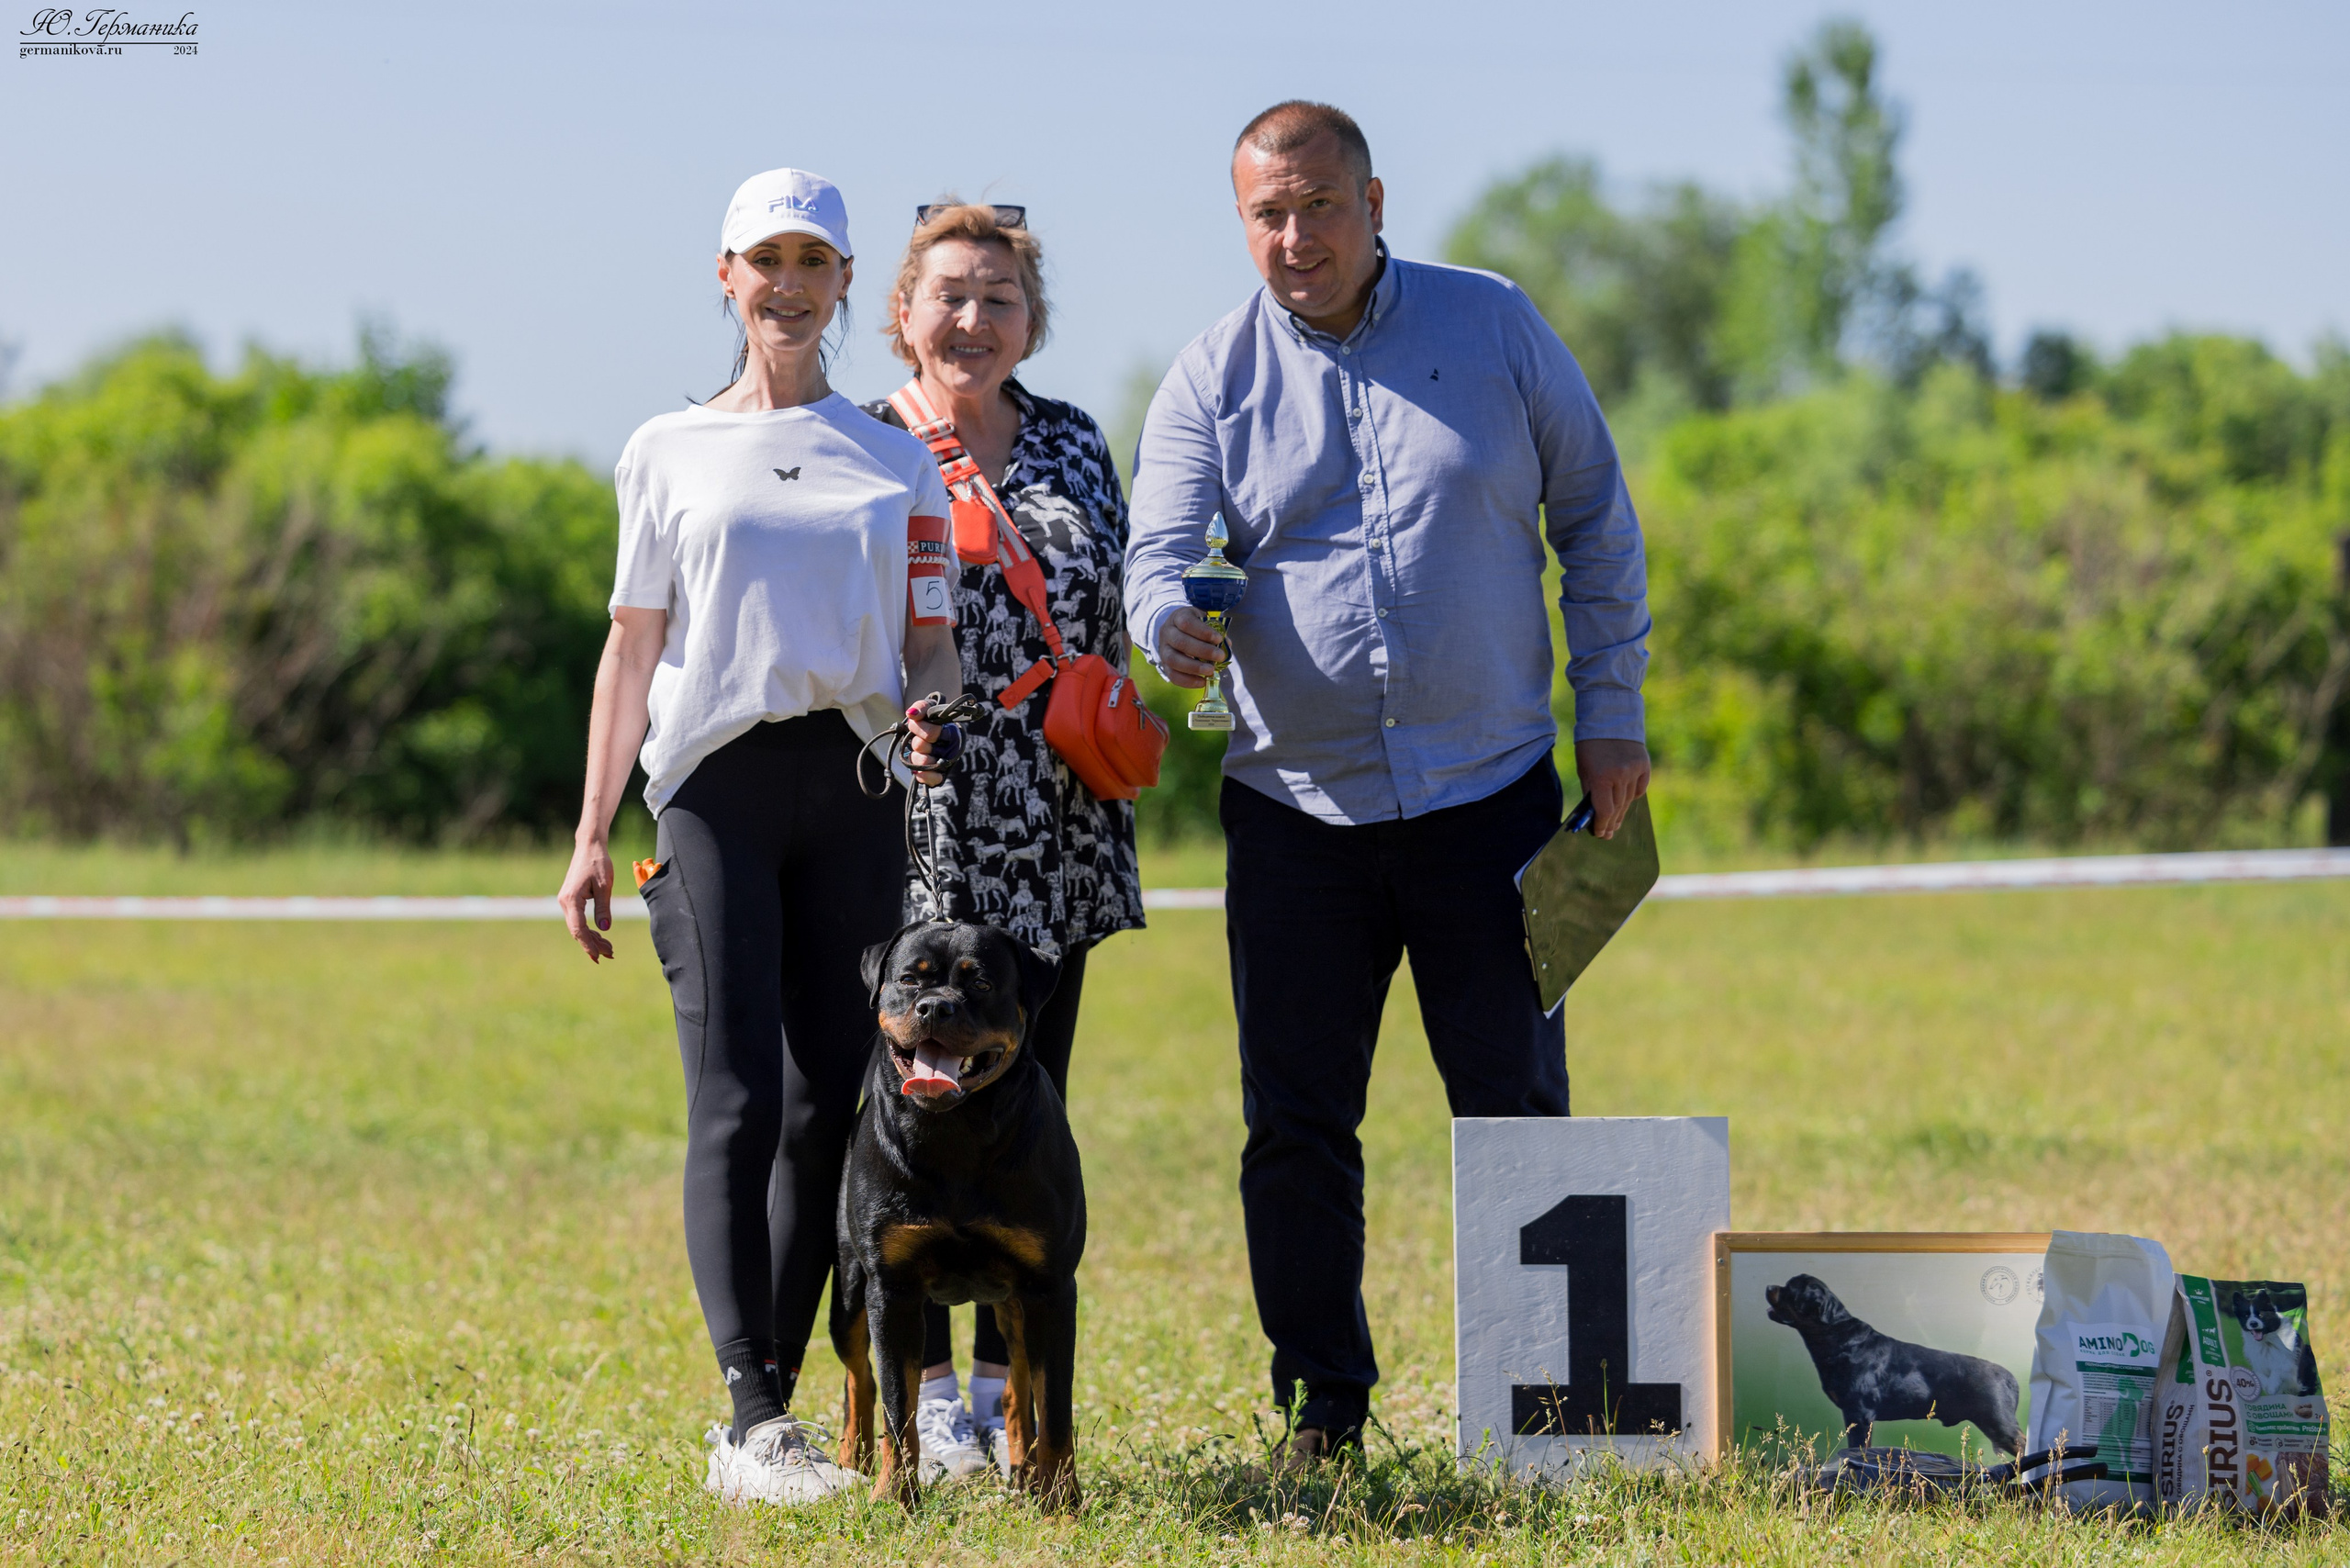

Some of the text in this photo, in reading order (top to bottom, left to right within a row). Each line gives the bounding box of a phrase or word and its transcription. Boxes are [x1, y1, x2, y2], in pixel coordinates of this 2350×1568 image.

[767, 195, 820, 213] FILA
[925, 580, 952, 610] 5
[1512, 1194, 1681, 1435] 1
[2236, 1378, 2255, 1388] 40%
[2244, 1403, 2287, 1412] ГОВЯДИНА
[2252, 1411, 2294, 1419] ОВОЩАМИ
[2178, 1405, 2195, 1445] ОВОЩАМИ
[2161, 1404, 2184, 1497] SIRIUS
[2206, 1379, 2238, 1513] SIRIUS
